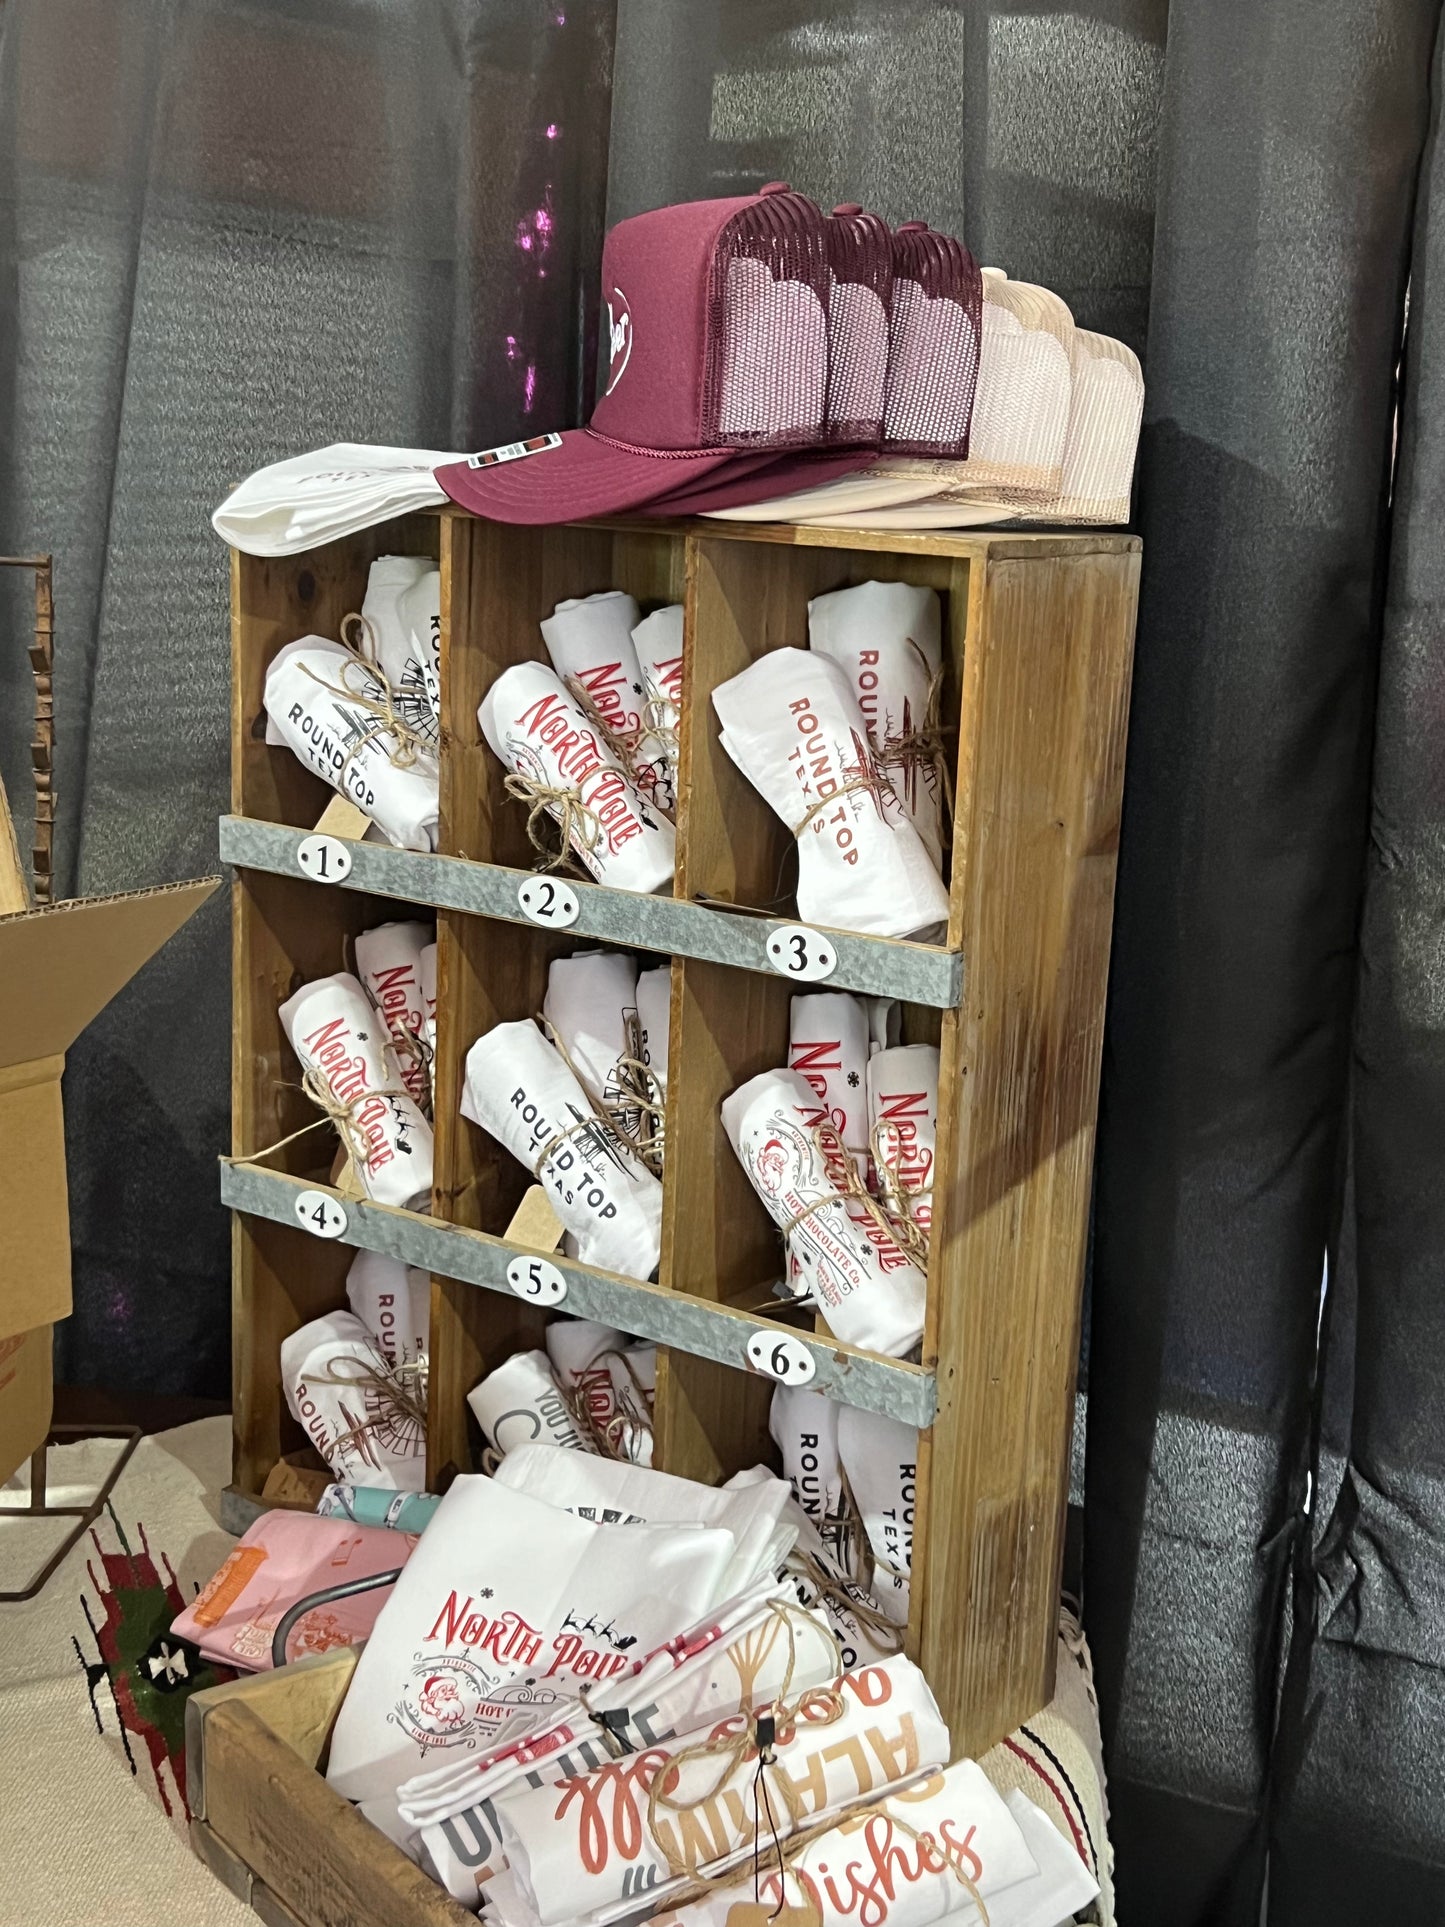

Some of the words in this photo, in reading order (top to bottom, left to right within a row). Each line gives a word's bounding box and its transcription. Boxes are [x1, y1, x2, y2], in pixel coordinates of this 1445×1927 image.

[288, 703, 344, 770] ROUND
[347, 767, 375, 806] TOP
[514, 693, 605, 785] NORTH
[585, 771, 644, 857] POLE
[789, 697, 837, 800] ROUND
[830, 806, 859, 866] TOP
[316, 846, 329, 878] 1
[537, 883, 557, 917] 2
[789, 935, 808, 971] 3
[303, 1017, 371, 1105] NORTH
[312, 1201, 327, 1229] 4
[577, 1172, 618, 1219] TOP
[784, 1191, 806, 1219] HOT
[803, 1213, 852, 1270] CHOCOLATE
[526, 1263, 543, 1295] 5
[771, 1343, 790, 1376] 6
[534, 1387, 570, 1428] YOU
[423, 1588, 547, 1668] NORTH
[475, 1703, 500, 1719] HOT
